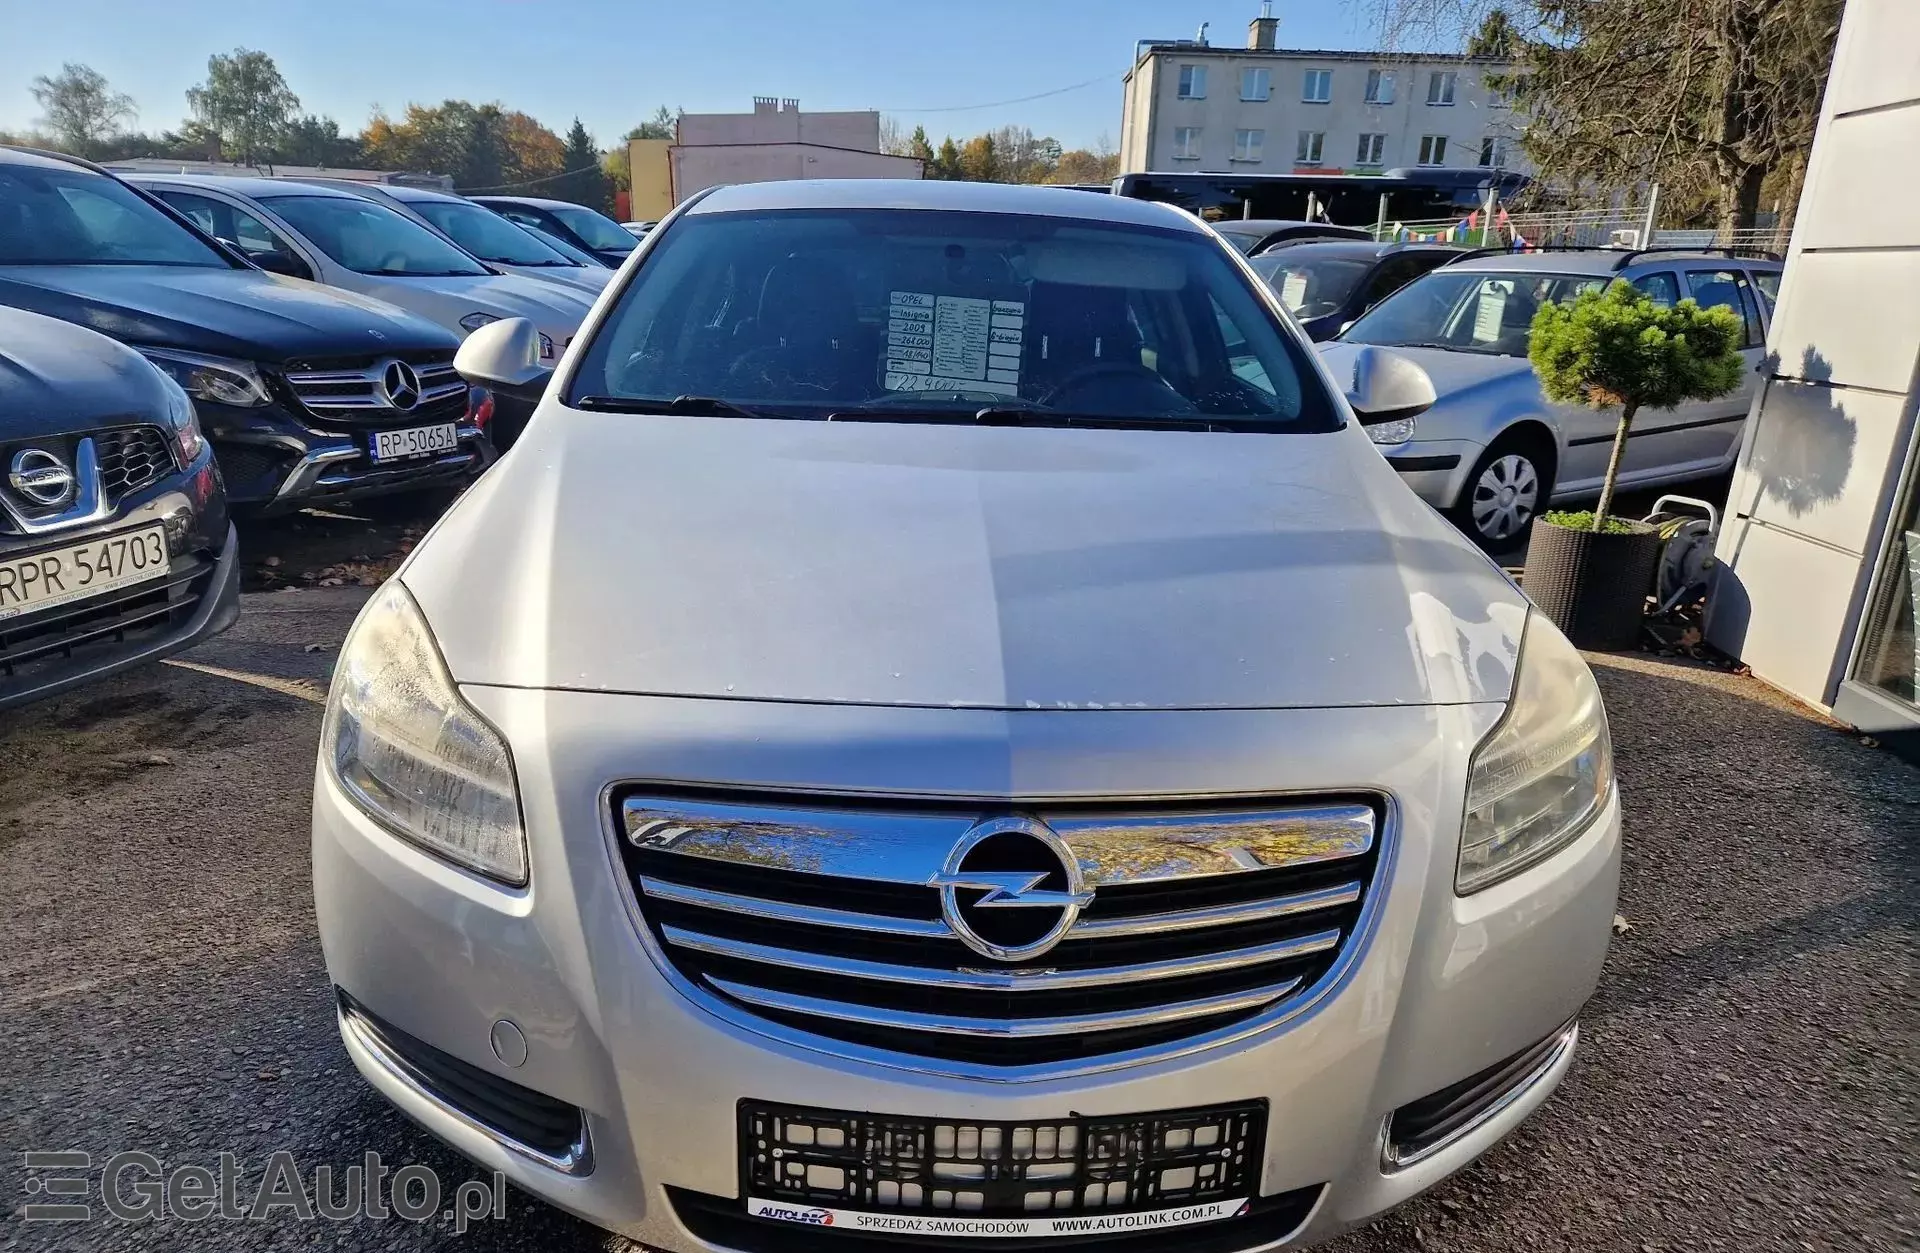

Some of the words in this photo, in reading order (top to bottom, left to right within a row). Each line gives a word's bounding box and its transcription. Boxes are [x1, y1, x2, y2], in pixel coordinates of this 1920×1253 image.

[901, 294, 923, 305] OPEL
[903, 322, 926, 333] 2009
[380, 433, 402, 456] RP
[407, 426, 454, 452] 5065A
[0, 556, 66, 606] RPR
[73, 532, 163, 585] 54703
[758, 1206, 823, 1225] AUTOLINK
[856, 1215, 923, 1231] SPRZEDAŻ
[926, 1220, 1030, 1233] SAMOCHODÓW
[1052, 1204, 1223, 1232] WWW.AUTOLINK.COM.PL
